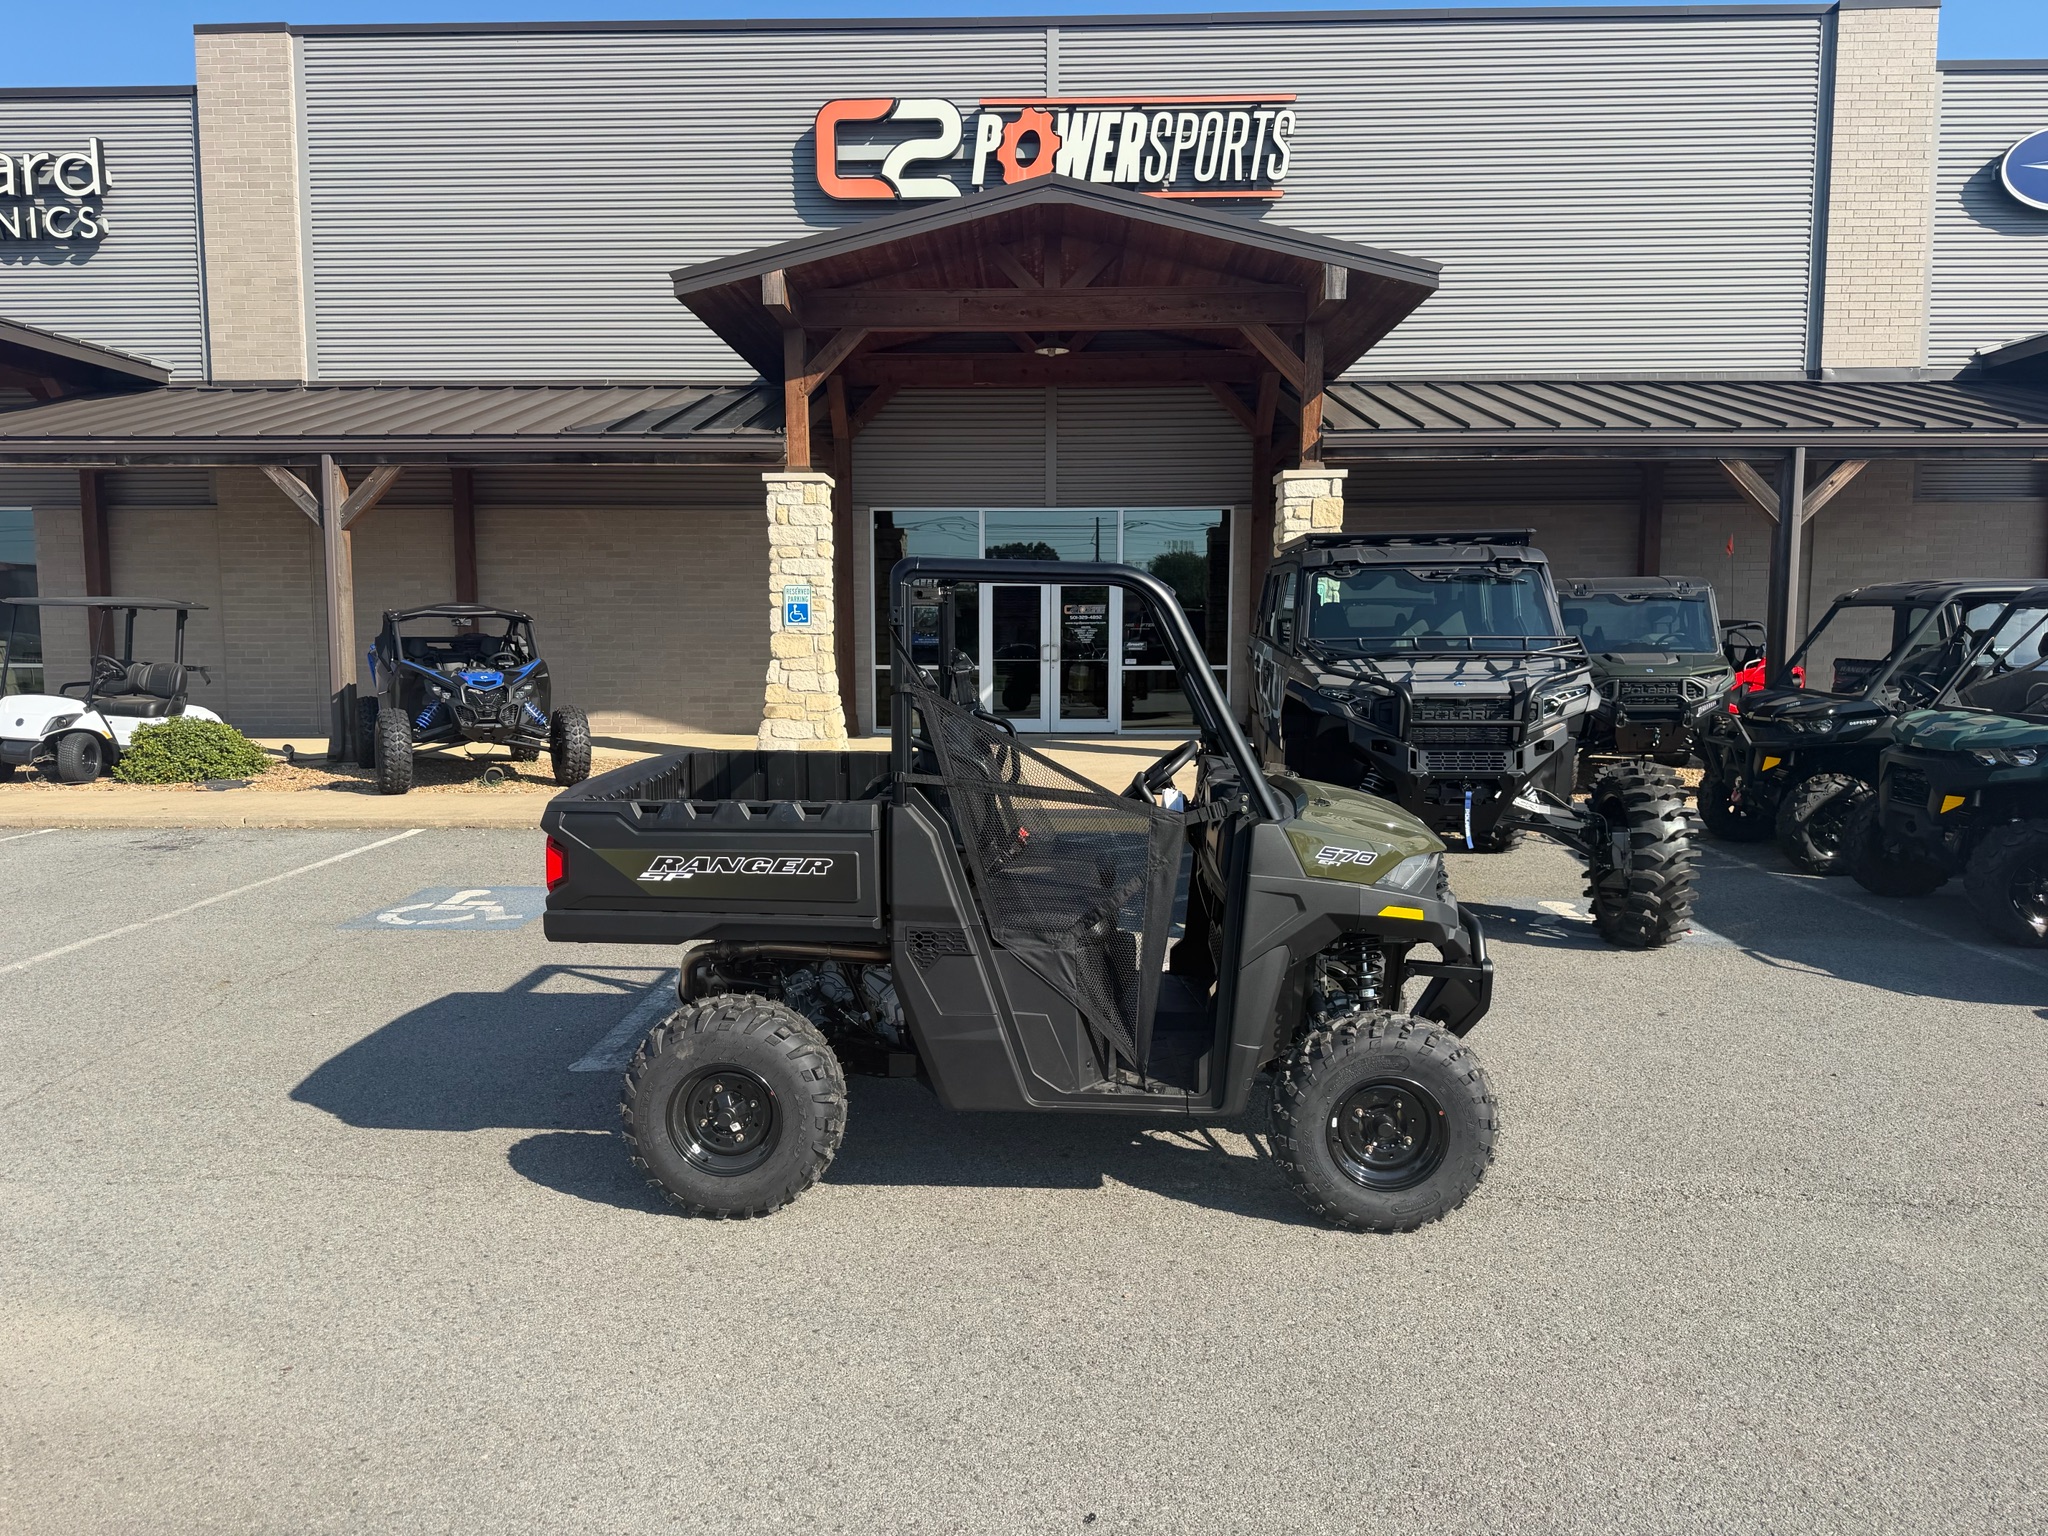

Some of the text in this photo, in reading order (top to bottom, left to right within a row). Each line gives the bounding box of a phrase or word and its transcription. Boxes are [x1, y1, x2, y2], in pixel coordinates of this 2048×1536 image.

[814, 97, 1297, 200] C2 POWERSPORTS
[1621, 687, 1679, 696] POLARIS
[1421, 710, 1509, 720] POLARI
[1315, 845, 1378, 866] 570
[648, 855, 834, 876] RANGER
[1317, 859, 1342, 867] EFI
[636, 871, 695, 882] SP
